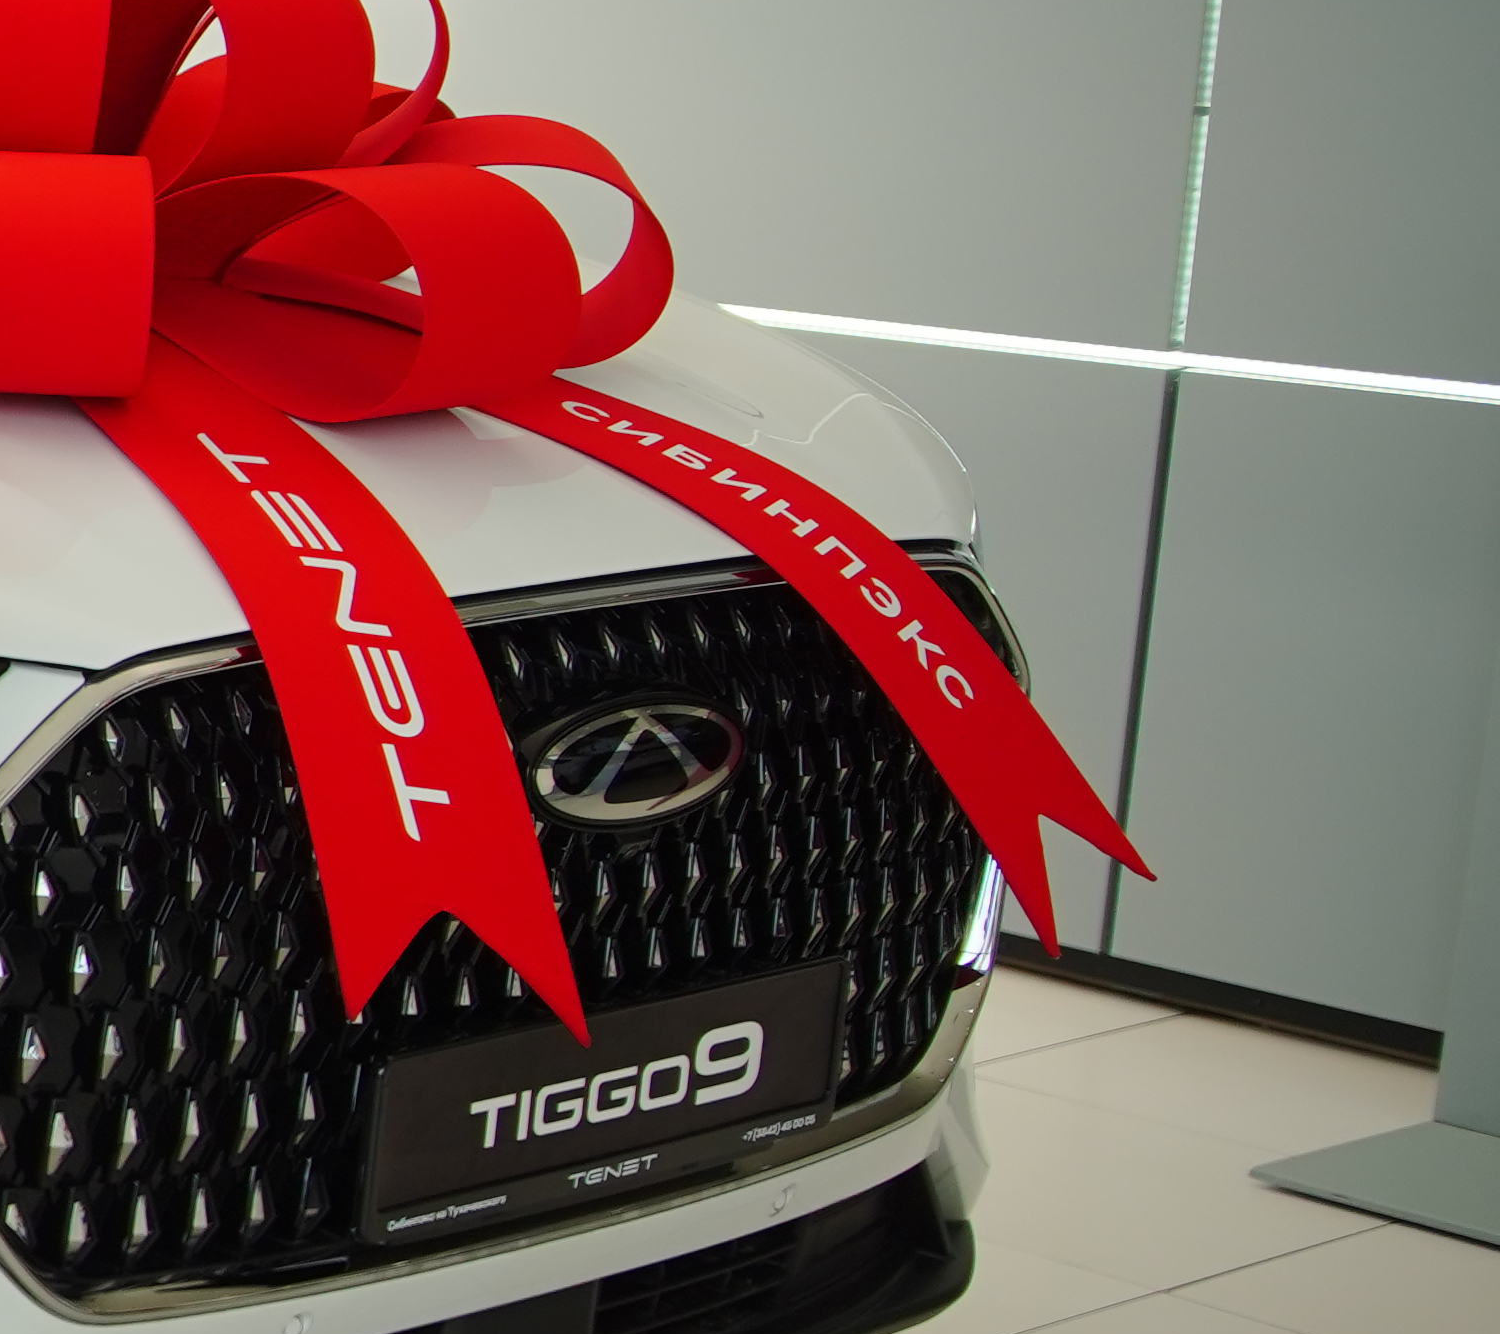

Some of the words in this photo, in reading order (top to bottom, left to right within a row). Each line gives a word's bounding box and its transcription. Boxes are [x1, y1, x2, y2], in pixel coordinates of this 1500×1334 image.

[196, 431, 452, 843] TENET
[561, 399, 975, 710] СИБИНПЭКС
[567, 1152, 660, 1190] TENET
